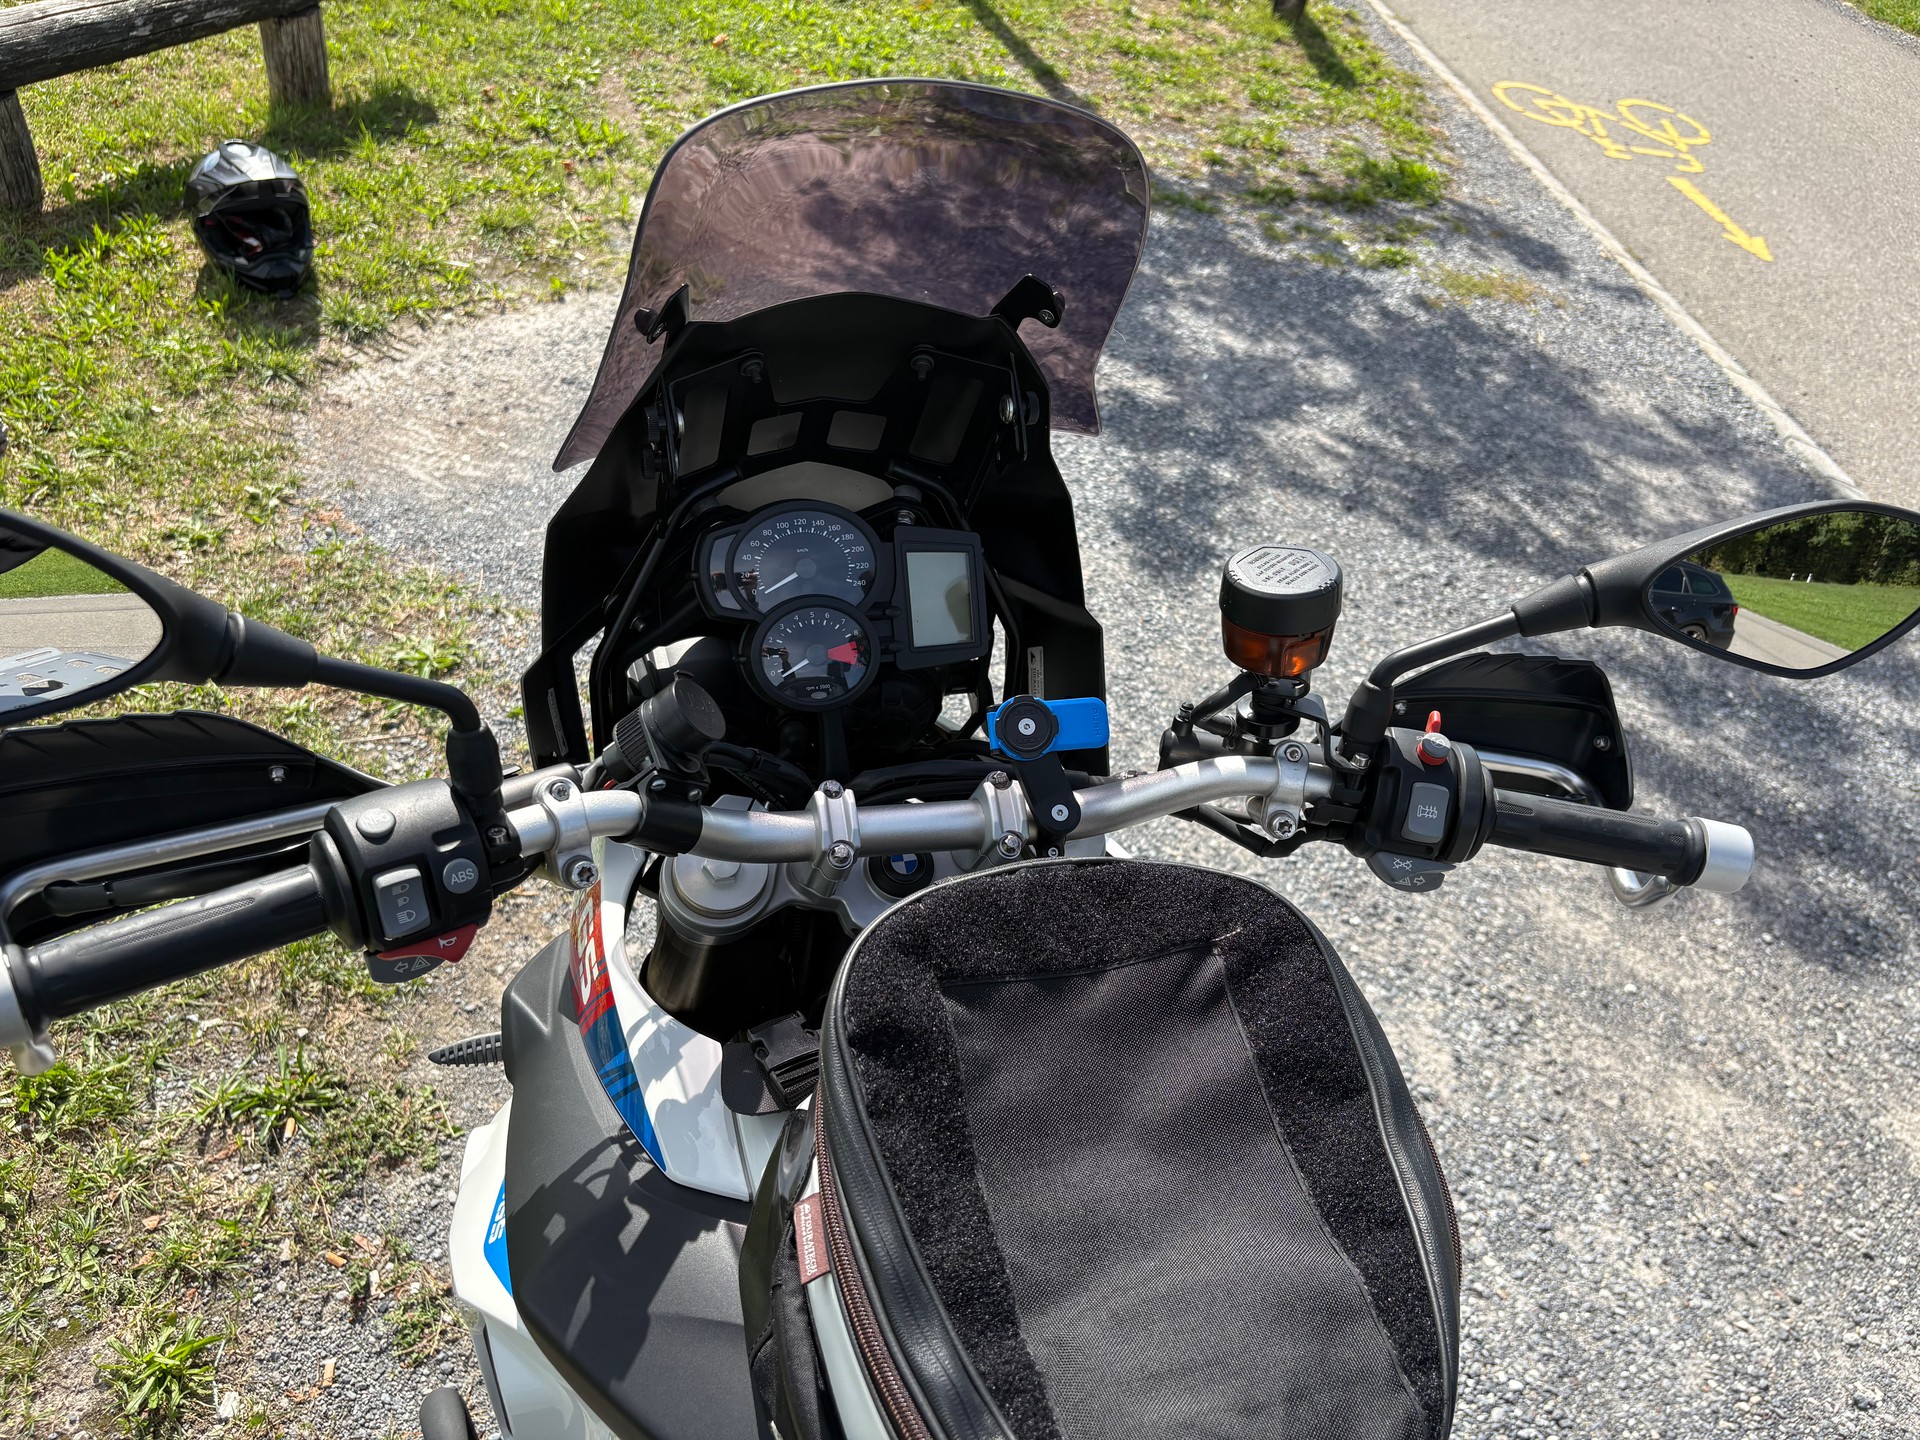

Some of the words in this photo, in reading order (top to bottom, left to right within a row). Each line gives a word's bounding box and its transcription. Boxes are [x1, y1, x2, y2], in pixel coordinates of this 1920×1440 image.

[361, 811, 390, 828] INFO
[451, 868, 475, 885] ABS
[577, 897, 598, 1005] GS
[805, 1214, 818, 1273] TOURATECH
